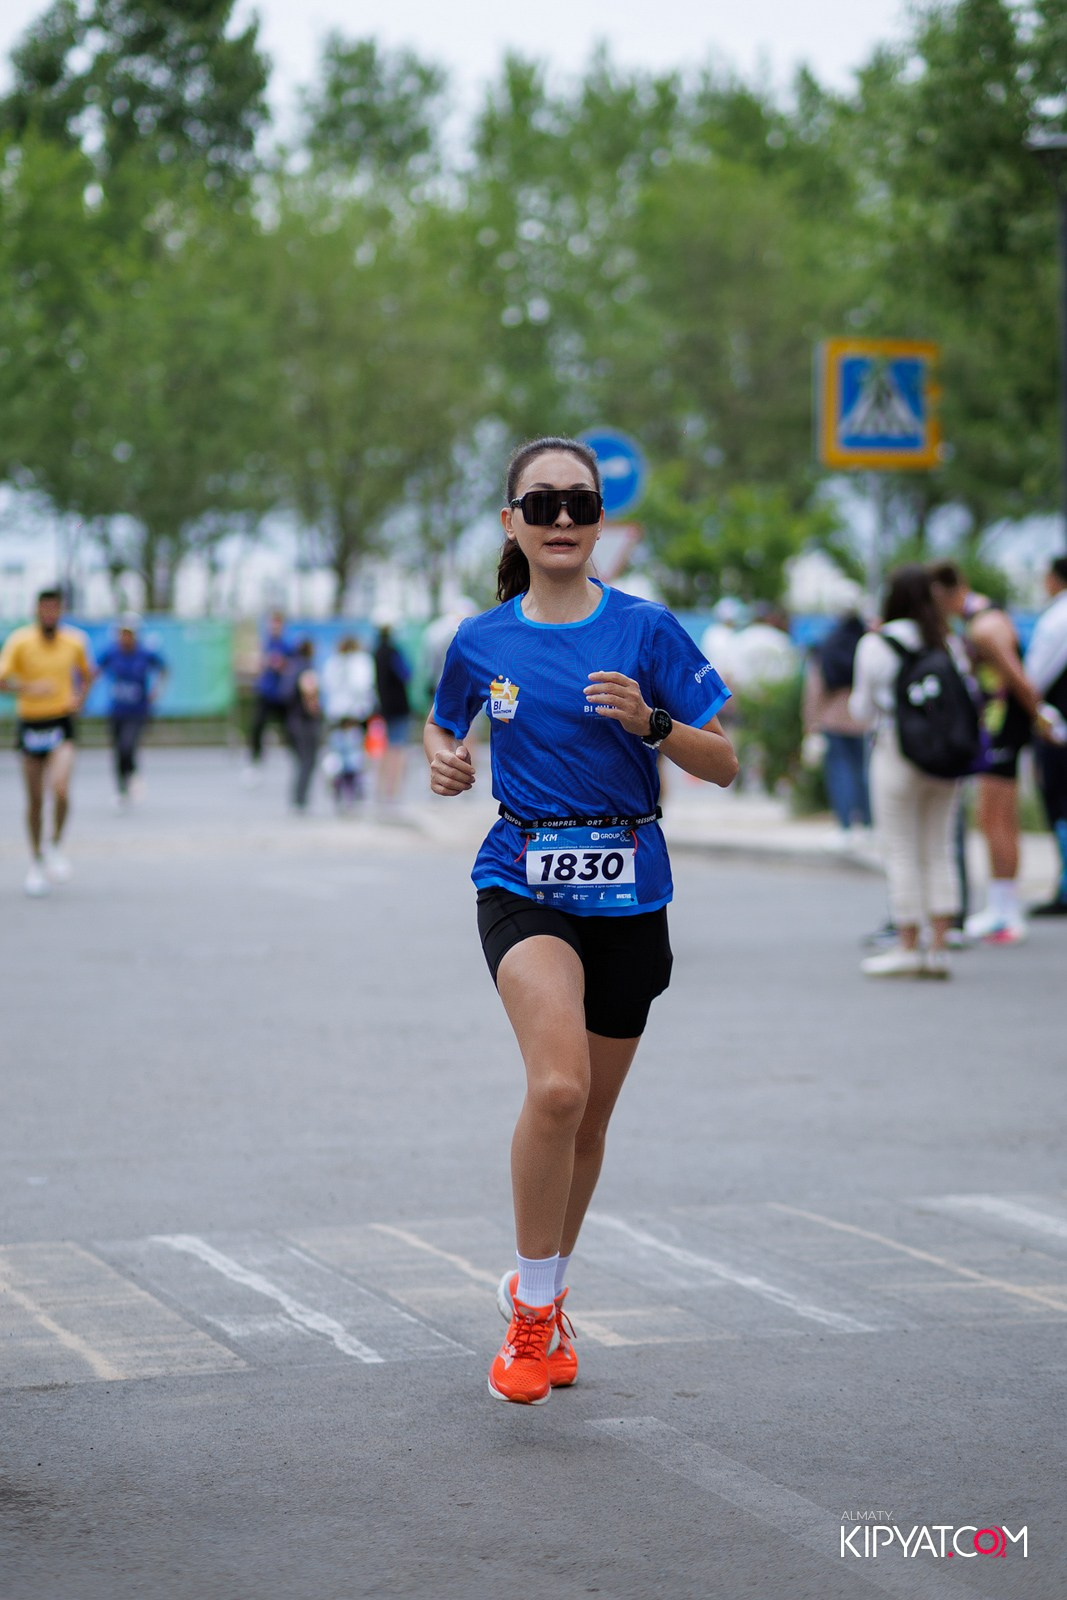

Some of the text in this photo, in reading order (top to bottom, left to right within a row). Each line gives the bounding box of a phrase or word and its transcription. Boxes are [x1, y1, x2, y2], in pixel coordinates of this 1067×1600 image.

[494, 701, 502, 710] BI
[583, 705, 593, 713] BI
[542, 833, 558, 842] KM
[540, 852, 624, 881] 1830
